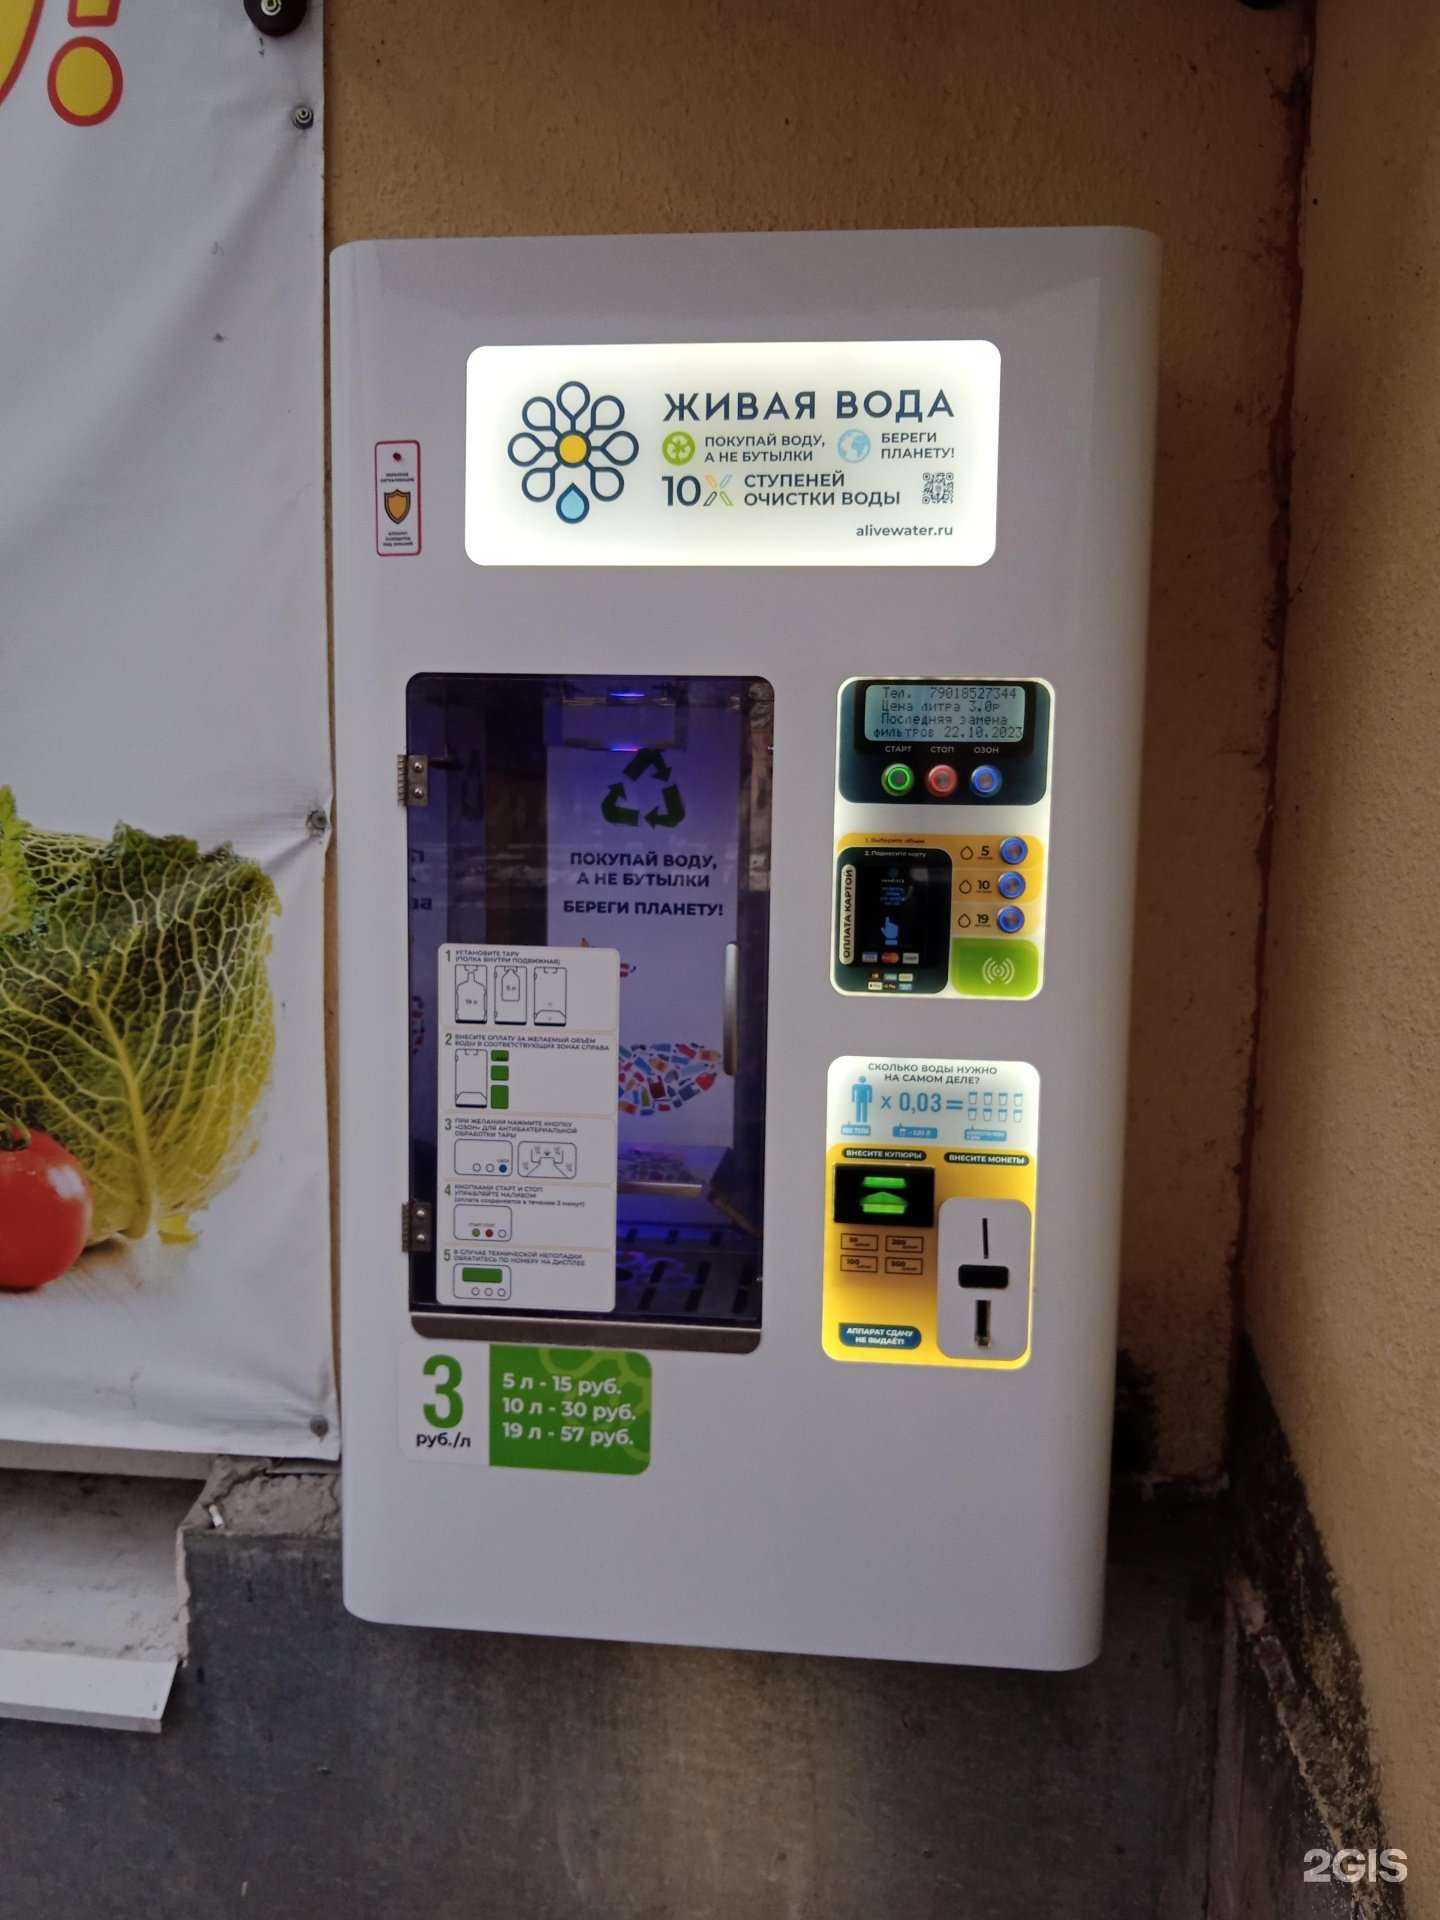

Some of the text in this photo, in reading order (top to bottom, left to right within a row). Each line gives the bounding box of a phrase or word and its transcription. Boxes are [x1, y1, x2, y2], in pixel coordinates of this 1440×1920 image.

[663, 388, 955, 424] ЖИВАЯ ВОДА
[704, 431, 826, 450] ПОКУПАЙ ВОДУ,
[881, 432, 938, 444] БЕРЕГИ
[704, 450, 814, 463] А НЕ БУТЫЛКИ
[880, 447, 955, 460] ПЛАНЕТУ!
[743, 470, 845, 488] СТУПЕНЕЙ
[743, 491, 901, 508] ОЧИСТКИ ВОДЫ
[855, 523, 954, 538] alivewater.ru
[884, 687, 911, 699] Тел.
[881, 701, 913, 712] Цена
[921, 703, 961, 712] литра
[881, 713, 1008, 726] Последняя замена
[943, 727, 1023, 739] 22.10.2023
[885, 745, 912, 753] СТАРТ
[981, 846, 990, 856] 5
[570, 851, 717, 871] ПОКУПАЙ ВОДУ,
[577, 872, 710, 887] А НЕ БУТЫЛКИ
[977, 880, 990, 890] 10
[563, 900, 723, 916] БЕРЕГИ ПЛАНЕТУ!
[843, 869, 853, 959] ОПЛАТА КАРТОЙ
[976, 914, 989, 924] 19
[446, 950, 451, 961] 1
[445, 1032, 452, 1045] 2
[868, 1063, 998, 1075] СКОЛЬКО ВОДЫ НУЖНО
[884, 1073, 980, 1085] НА САМОМ ДЕЛЕ?
[899, 1091, 942, 1115] 0,03
[445, 1118, 451, 1130] 3
[845, 1149, 922, 1159] ВНЕСИТЕ КУПЮРЫ
[949, 1154, 1025, 1164] ВНЕСИТЕ МОНЕТЫ
[444, 1184, 451, 1196] 4
[443, 1249, 451, 1261] 5
[847, 1327, 913, 1337] АППАРАТ СДАЧУ
[423, 1354, 463, 1428] 3
[503, 1373, 515, 1388] 5
[520, 1376, 533, 1389] л
[553, 1375, 572, 1391] 15
[578, 1377, 622, 1398] руб.
[503, 1397, 524, 1414] 10
[529, 1401, 542, 1415] л
[561, 1401, 587, 1417] 30
[592, 1403, 636, 1423] руб.
[416, 1432, 471, 1448] руб./л
[503, 1422, 523, 1438] 19
[528, 1425, 541, 1440] л
[560, 1426, 584, 1442] 57
[590, 1427, 634, 1446] руб.
